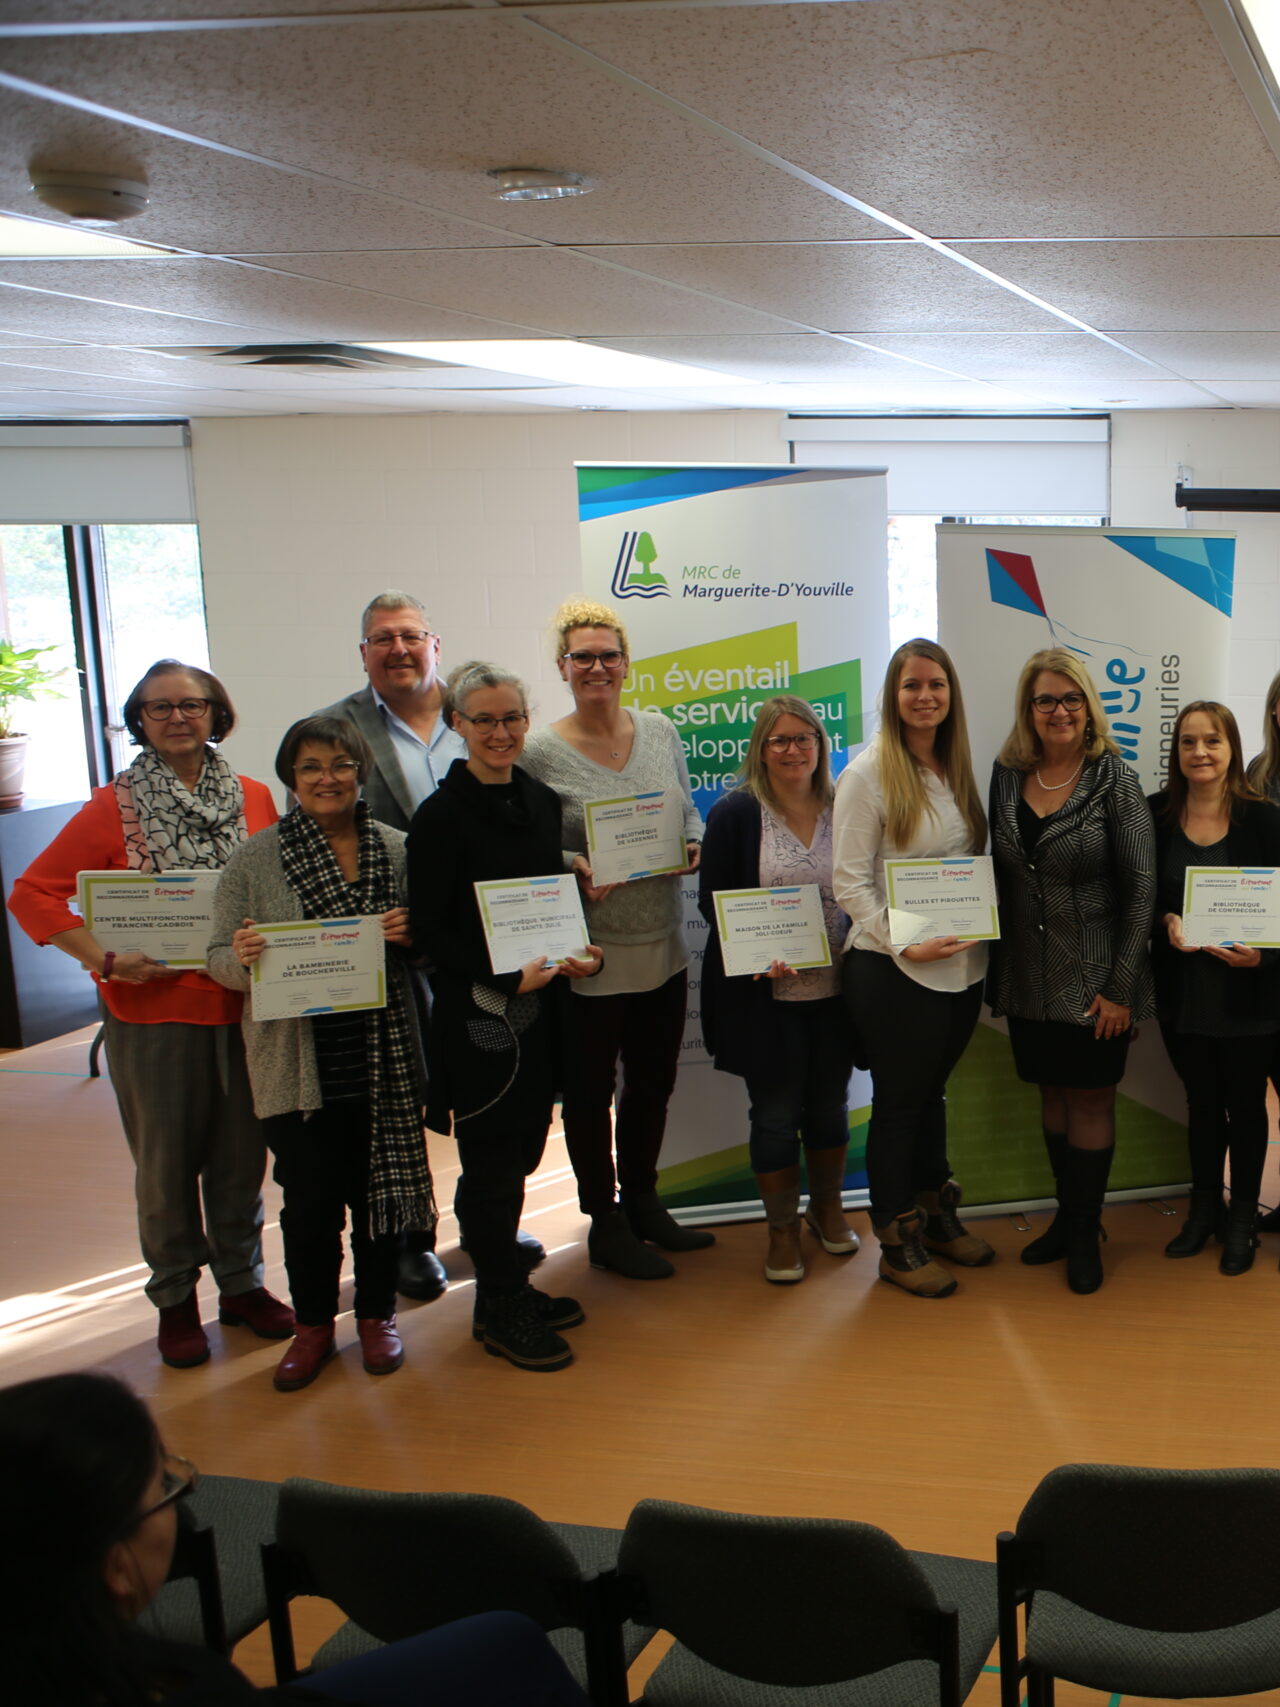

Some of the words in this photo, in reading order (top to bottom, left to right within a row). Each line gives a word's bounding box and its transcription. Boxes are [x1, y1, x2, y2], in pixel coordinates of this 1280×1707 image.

[682, 565, 719, 579] MRC
[722, 565, 741, 579] de
[683, 582, 854, 602] Marguerite-D'Youville
[663, 660, 790, 693] éventail
[672, 696, 764, 726] servic
[812, 702, 843, 721] au
[295, 965, 356, 977] BOUCHERVILLE
[299, 960, 349, 969] BAMBINERIE
